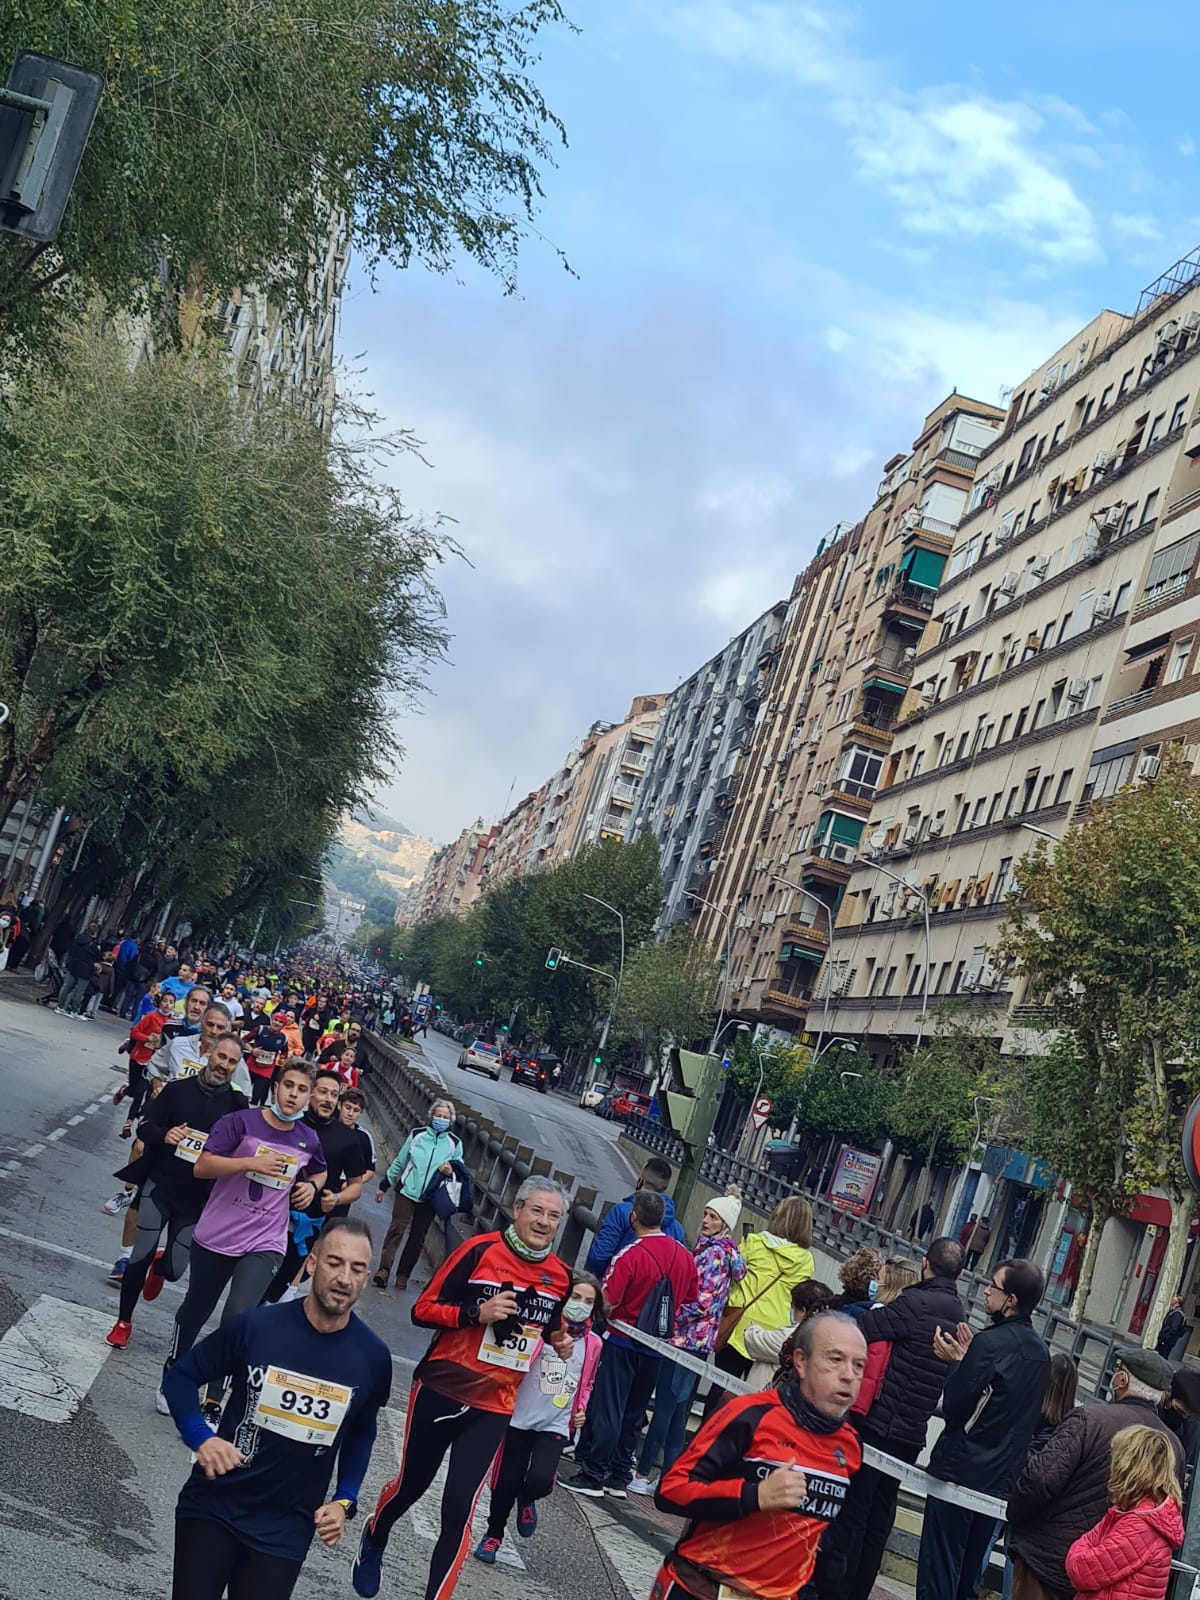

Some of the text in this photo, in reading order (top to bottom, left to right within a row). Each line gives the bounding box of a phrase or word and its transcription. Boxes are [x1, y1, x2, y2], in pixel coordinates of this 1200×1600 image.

[183, 1066, 199, 1077] 10
[186, 1137, 203, 1151] 78
[483, 1286, 500, 1297] CLU
[507, 1336, 528, 1352] 30
[280, 1390, 331, 1420] 933
